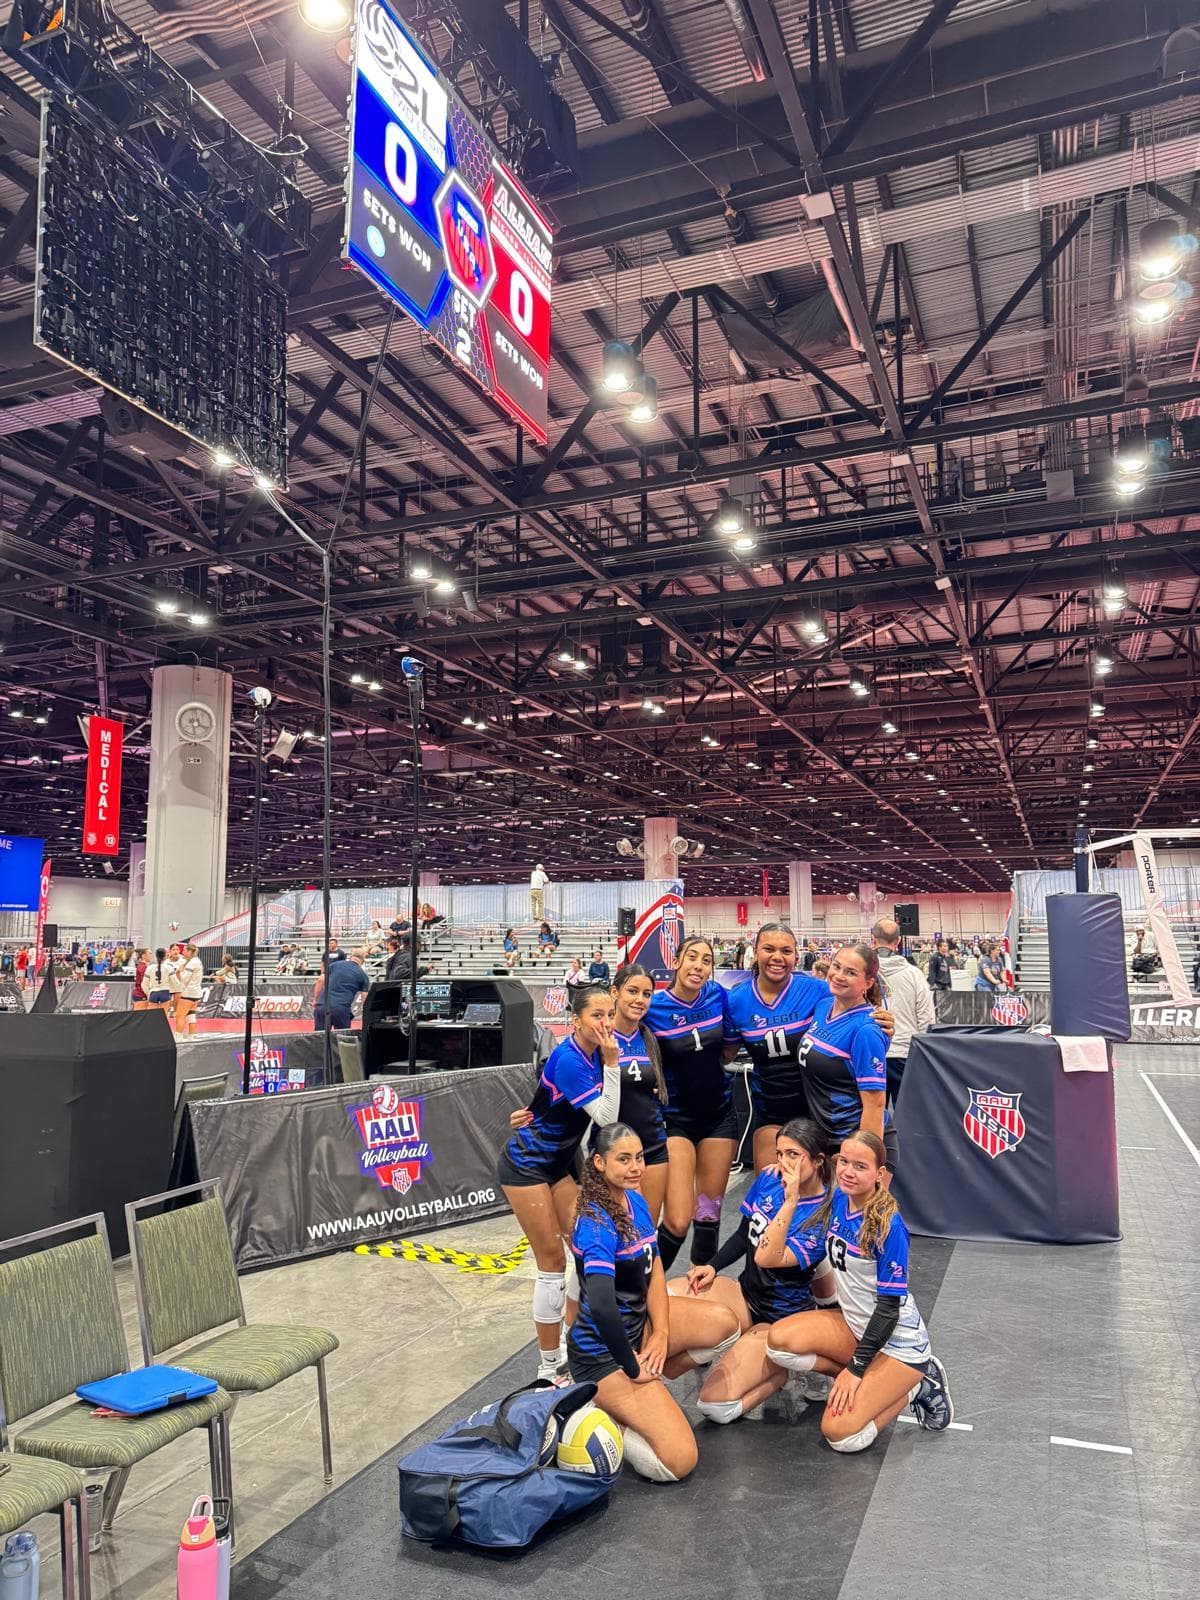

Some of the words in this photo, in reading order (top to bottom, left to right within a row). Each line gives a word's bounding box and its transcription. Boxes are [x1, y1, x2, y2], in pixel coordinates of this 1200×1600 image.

[385, 121, 418, 206] 0
[364, 188, 397, 235] SETS
[399, 226, 431, 272] WON
[454, 289, 476, 327] SET
[510, 270, 533, 336] 0
[455, 327, 471, 366] 2
[495, 331, 519, 364] SETS
[519, 359, 543, 390] WON
[98, 730, 111, 820] MEDICAL
[767, 1011, 800, 1024] LEGIT
[692, 1027, 704, 1052] 1
[764, 1028, 791, 1058] 11
[627, 1060, 642, 1082] 4
[978, 1095, 1011, 1107] AAU
[370, 1115, 415, 1142] AAU
[977, 1108, 1009, 1142] USA
[361, 1143, 429, 1168] Volleyball
[307, 1188, 496, 1240] WWW.AAUVOLLEYBALL.ORG
[643, 1243, 653, 1274] 3
[828, 1236, 847, 1272] 13
